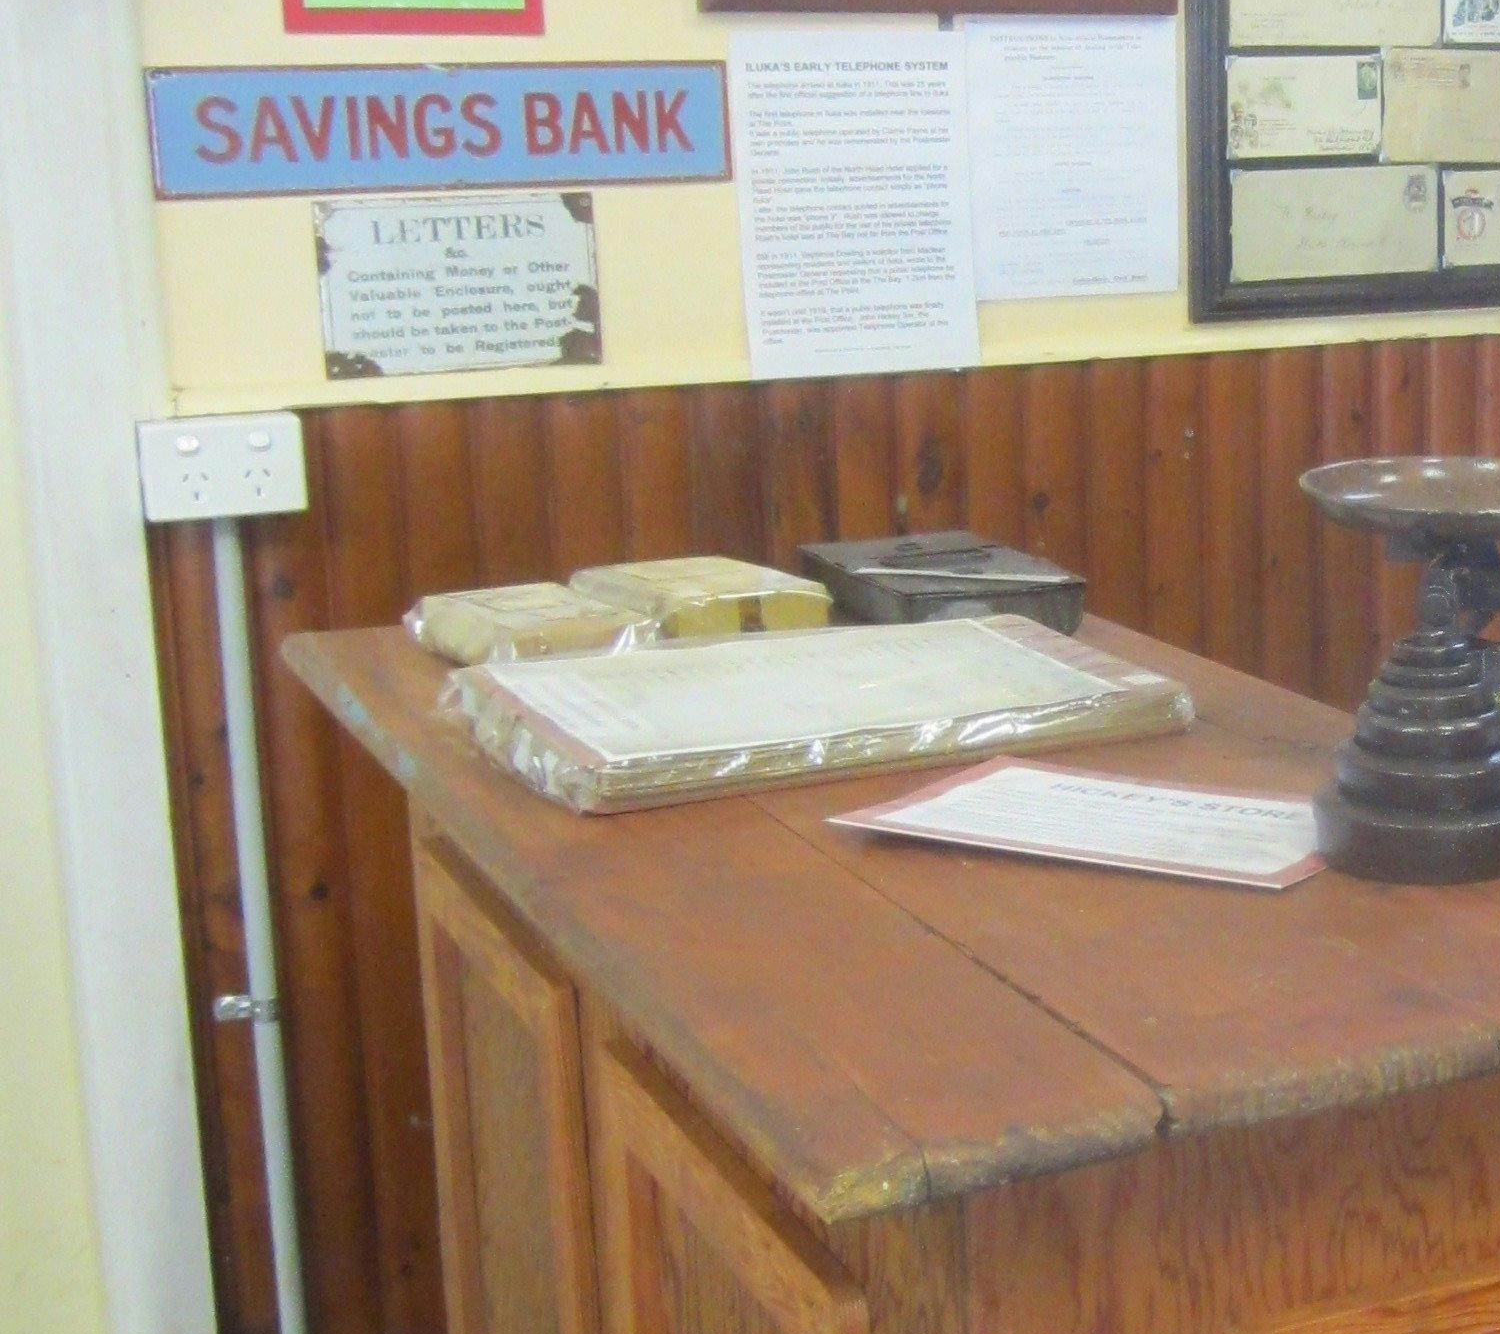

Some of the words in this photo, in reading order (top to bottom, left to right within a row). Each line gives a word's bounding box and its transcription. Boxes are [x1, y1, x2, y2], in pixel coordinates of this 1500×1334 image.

[794, 62, 830, 72] EARLY
[836, 61, 900, 72] TELEPHONE
[905, 61, 949, 71] SYSTEM
[194, 91, 501, 166] SAVINGS
[523, 89, 697, 157] BANK
[372, 214, 546, 245] LETTERS
[1198, 801, 1302, 819] STORE
